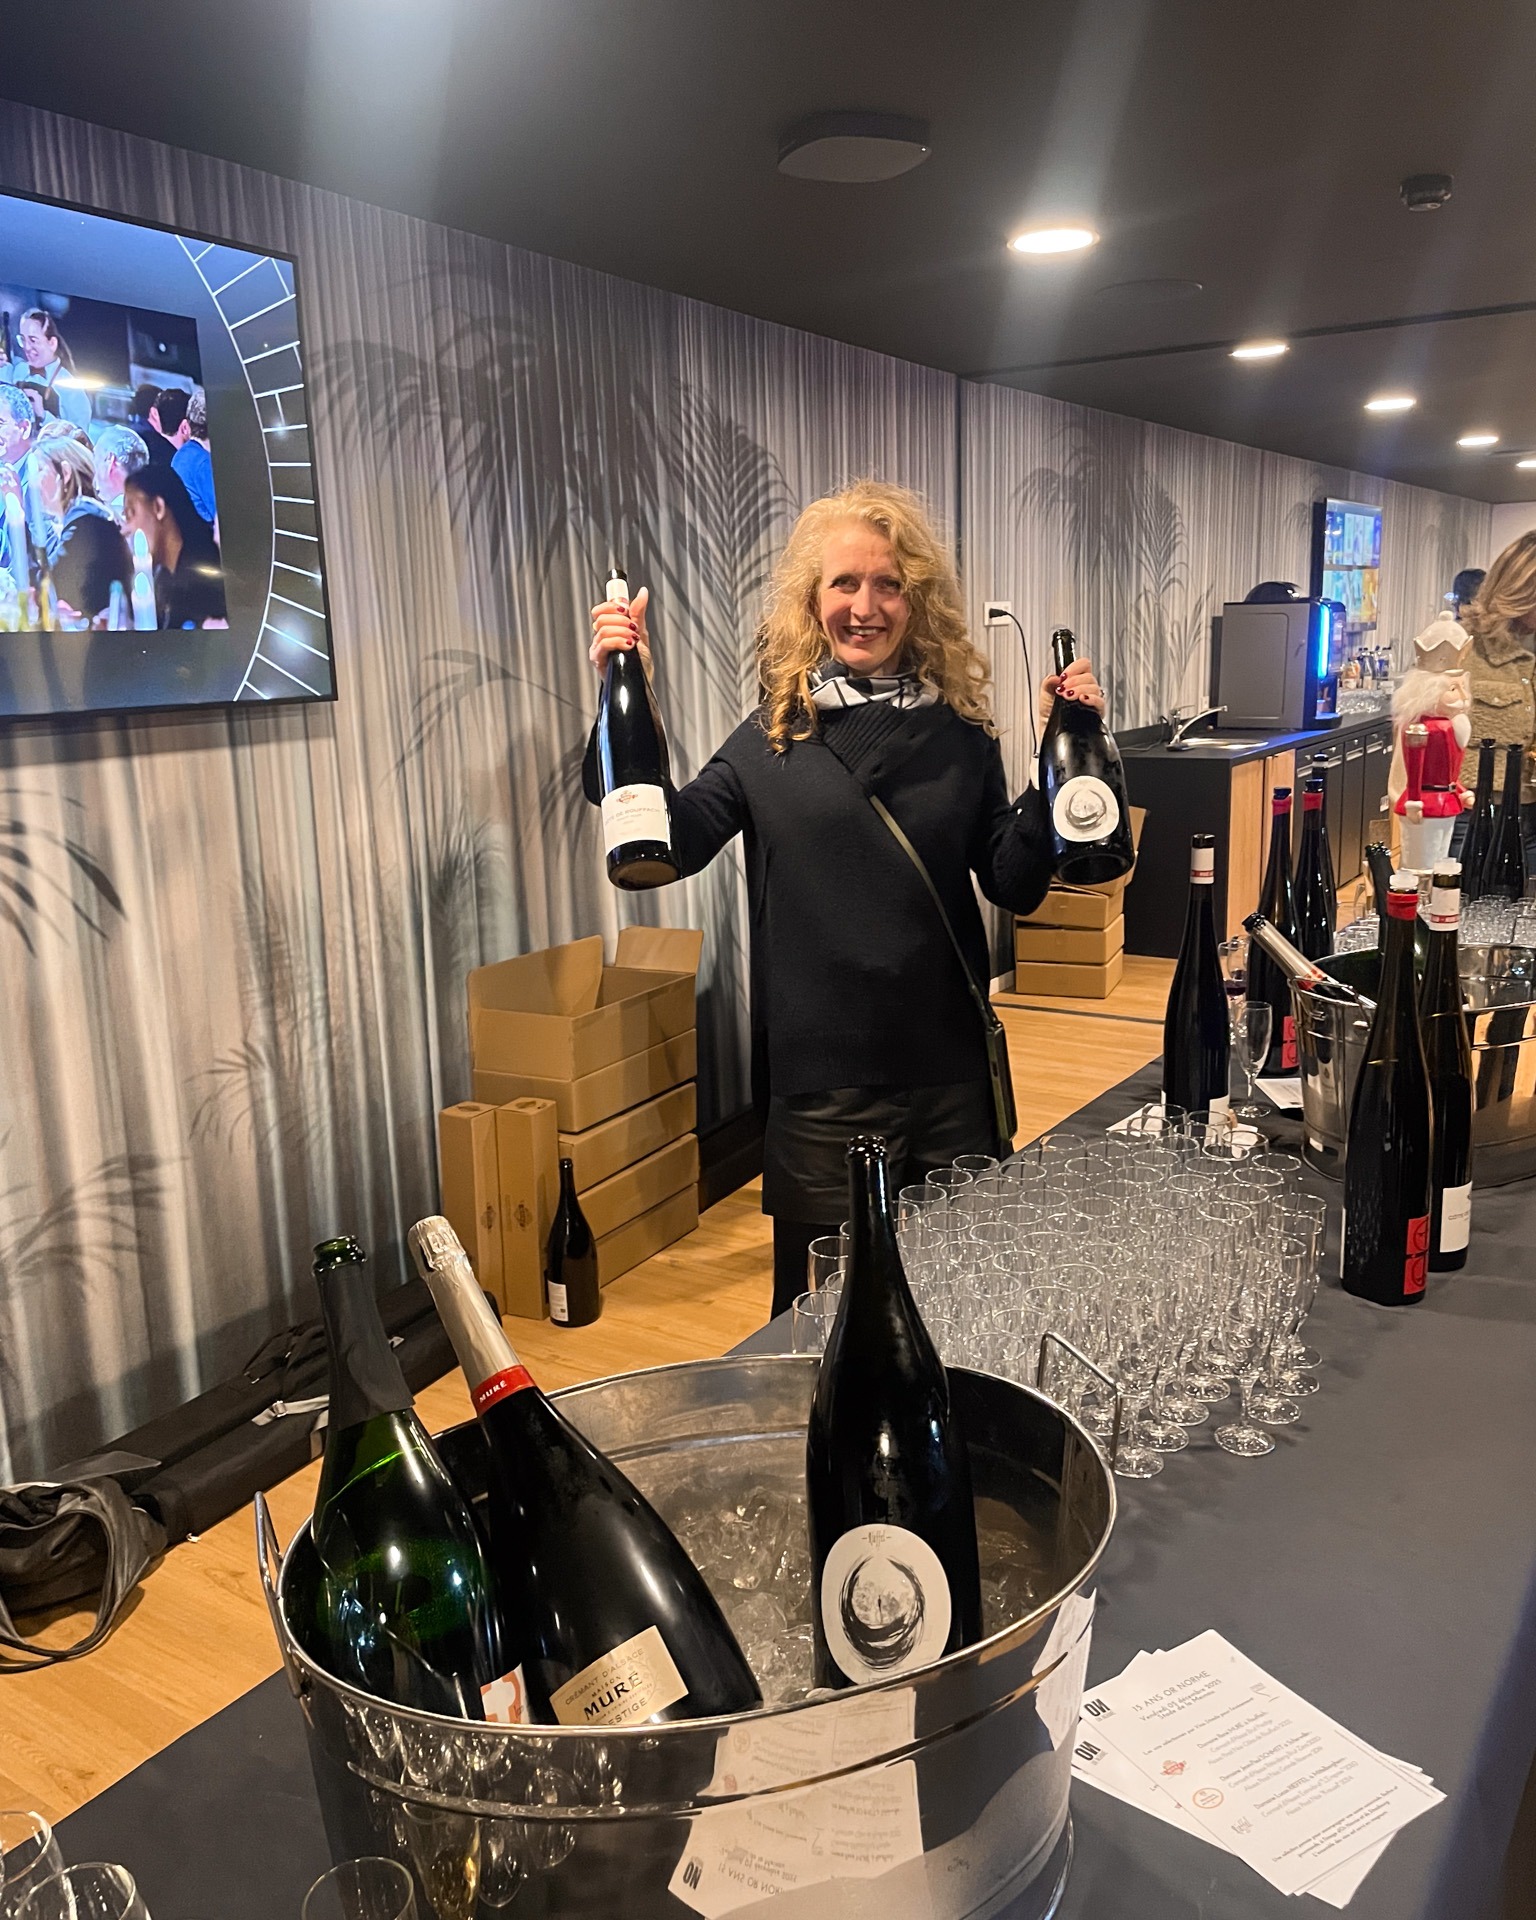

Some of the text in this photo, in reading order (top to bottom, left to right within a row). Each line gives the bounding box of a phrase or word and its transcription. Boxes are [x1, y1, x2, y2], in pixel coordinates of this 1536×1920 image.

[583, 1671, 643, 1721] MURÉ
[1141, 1693, 1164, 1707] ANS
[1162, 1686, 1178, 1696] OR
[1175, 1670, 1210, 1689] NORME
[602, 1697, 648, 1725] ESTIGE
